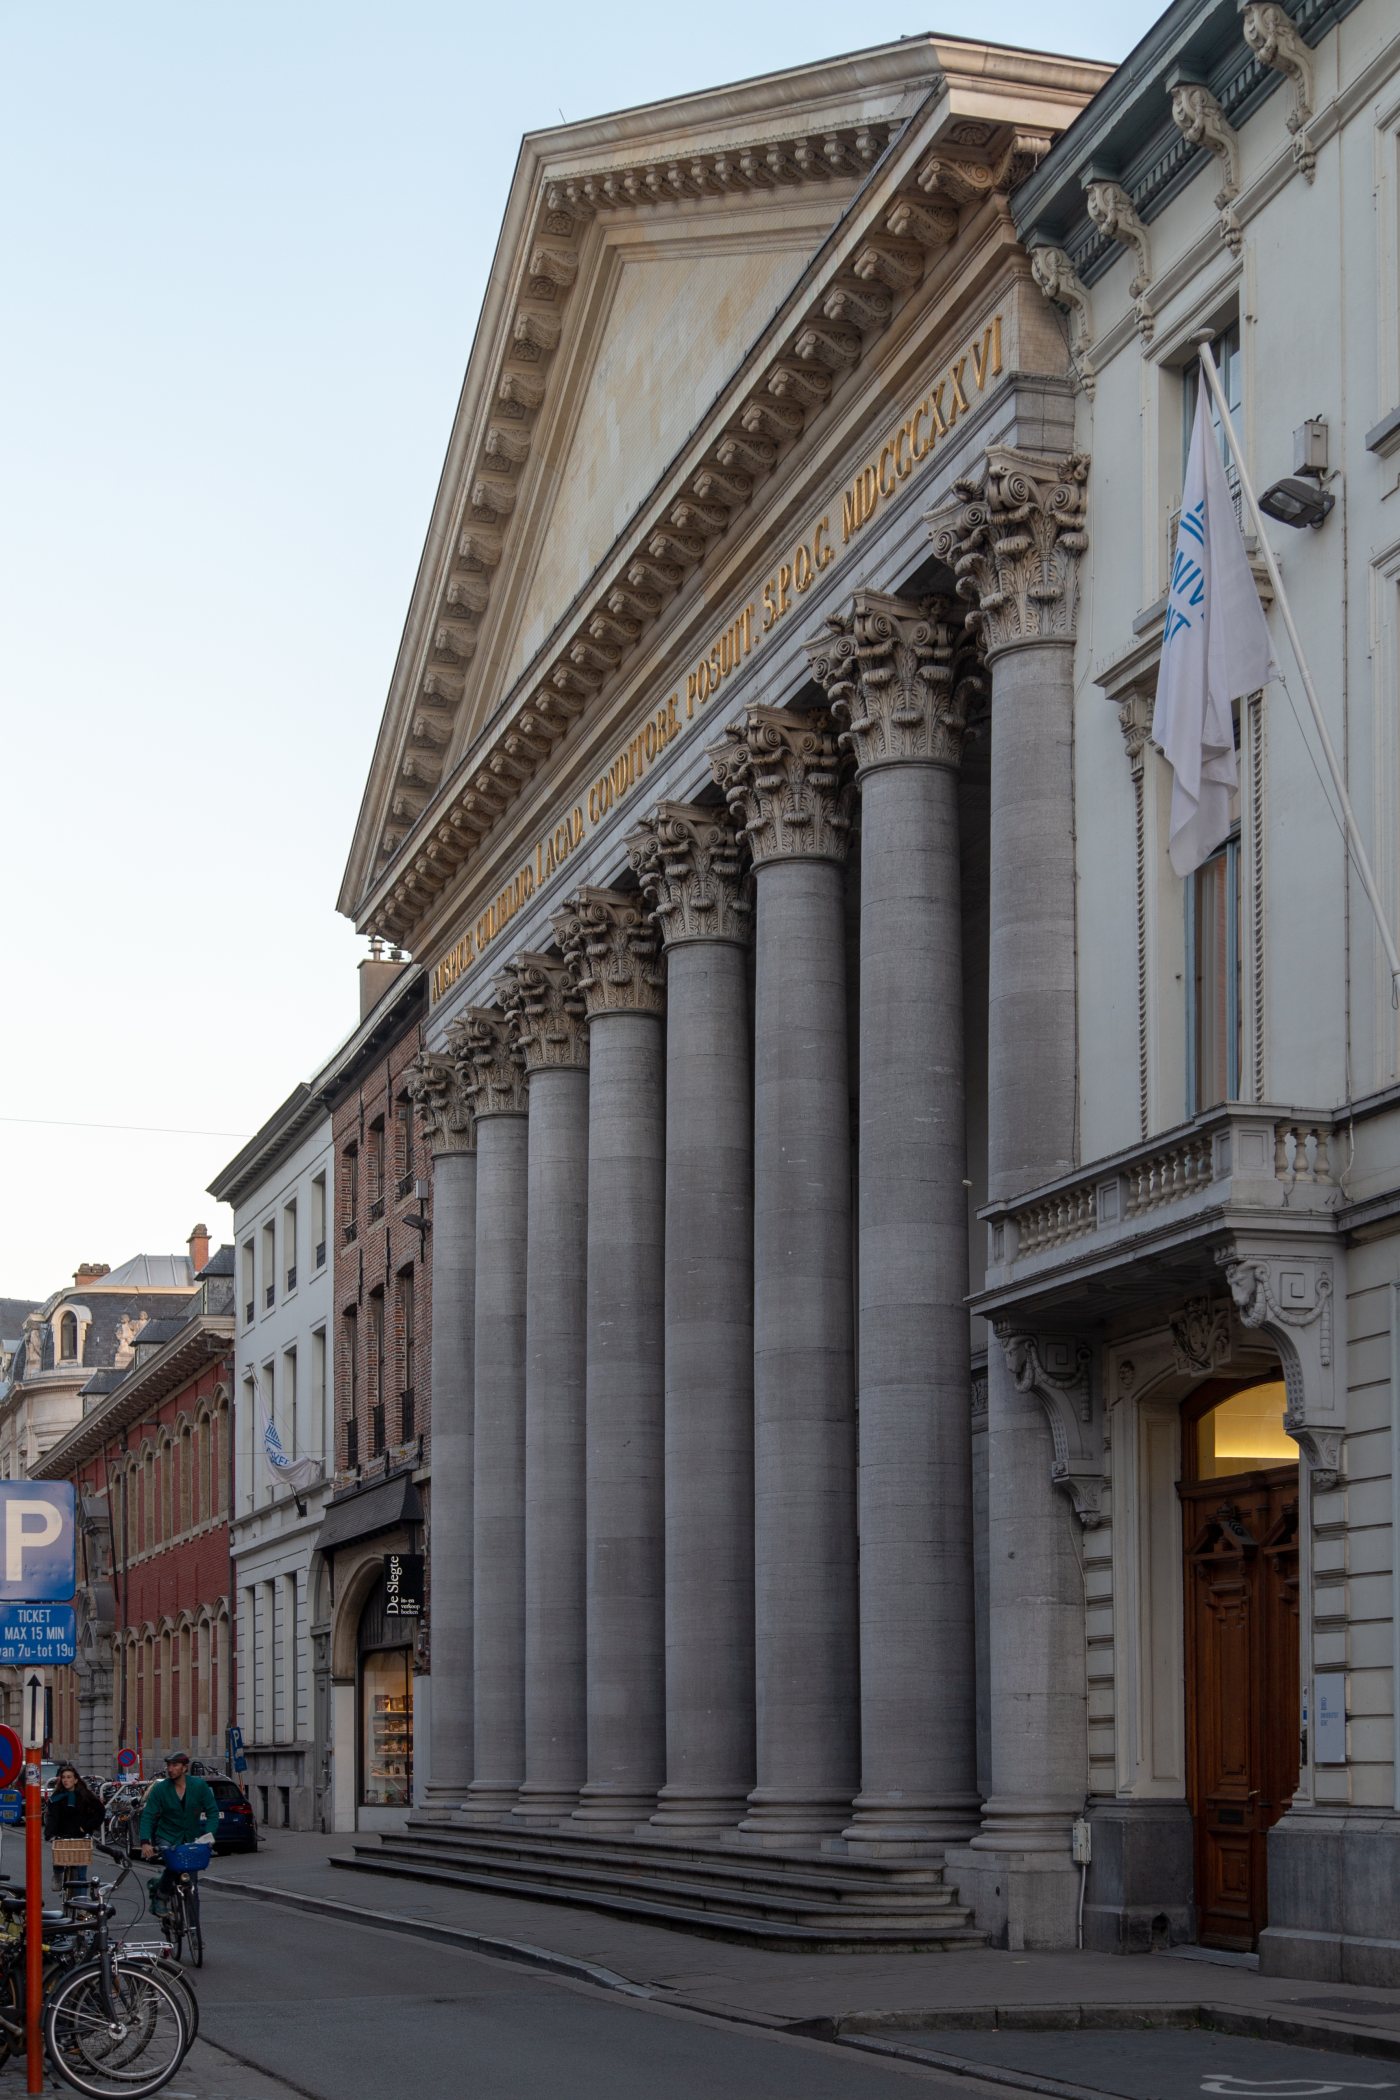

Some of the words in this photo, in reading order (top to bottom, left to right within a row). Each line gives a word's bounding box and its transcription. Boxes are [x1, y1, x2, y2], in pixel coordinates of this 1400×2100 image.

[841, 314, 1003, 545] MDCCCXXVI
[5, 1499, 63, 1582] P
[387, 1555, 402, 1593] Slegte
[387, 1596, 398, 1614] De
[17, 1609, 52, 1623] TICKET
[5, 1626, 27, 1640] MAX
[31, 1627, 43, 1640] 15
[46, 1627, 65, 1640] MIN
[0, 1647, 15, 1657] an
[56, 1643, 74, 1658] 19u
[232, 1729, 240, 1747] P
